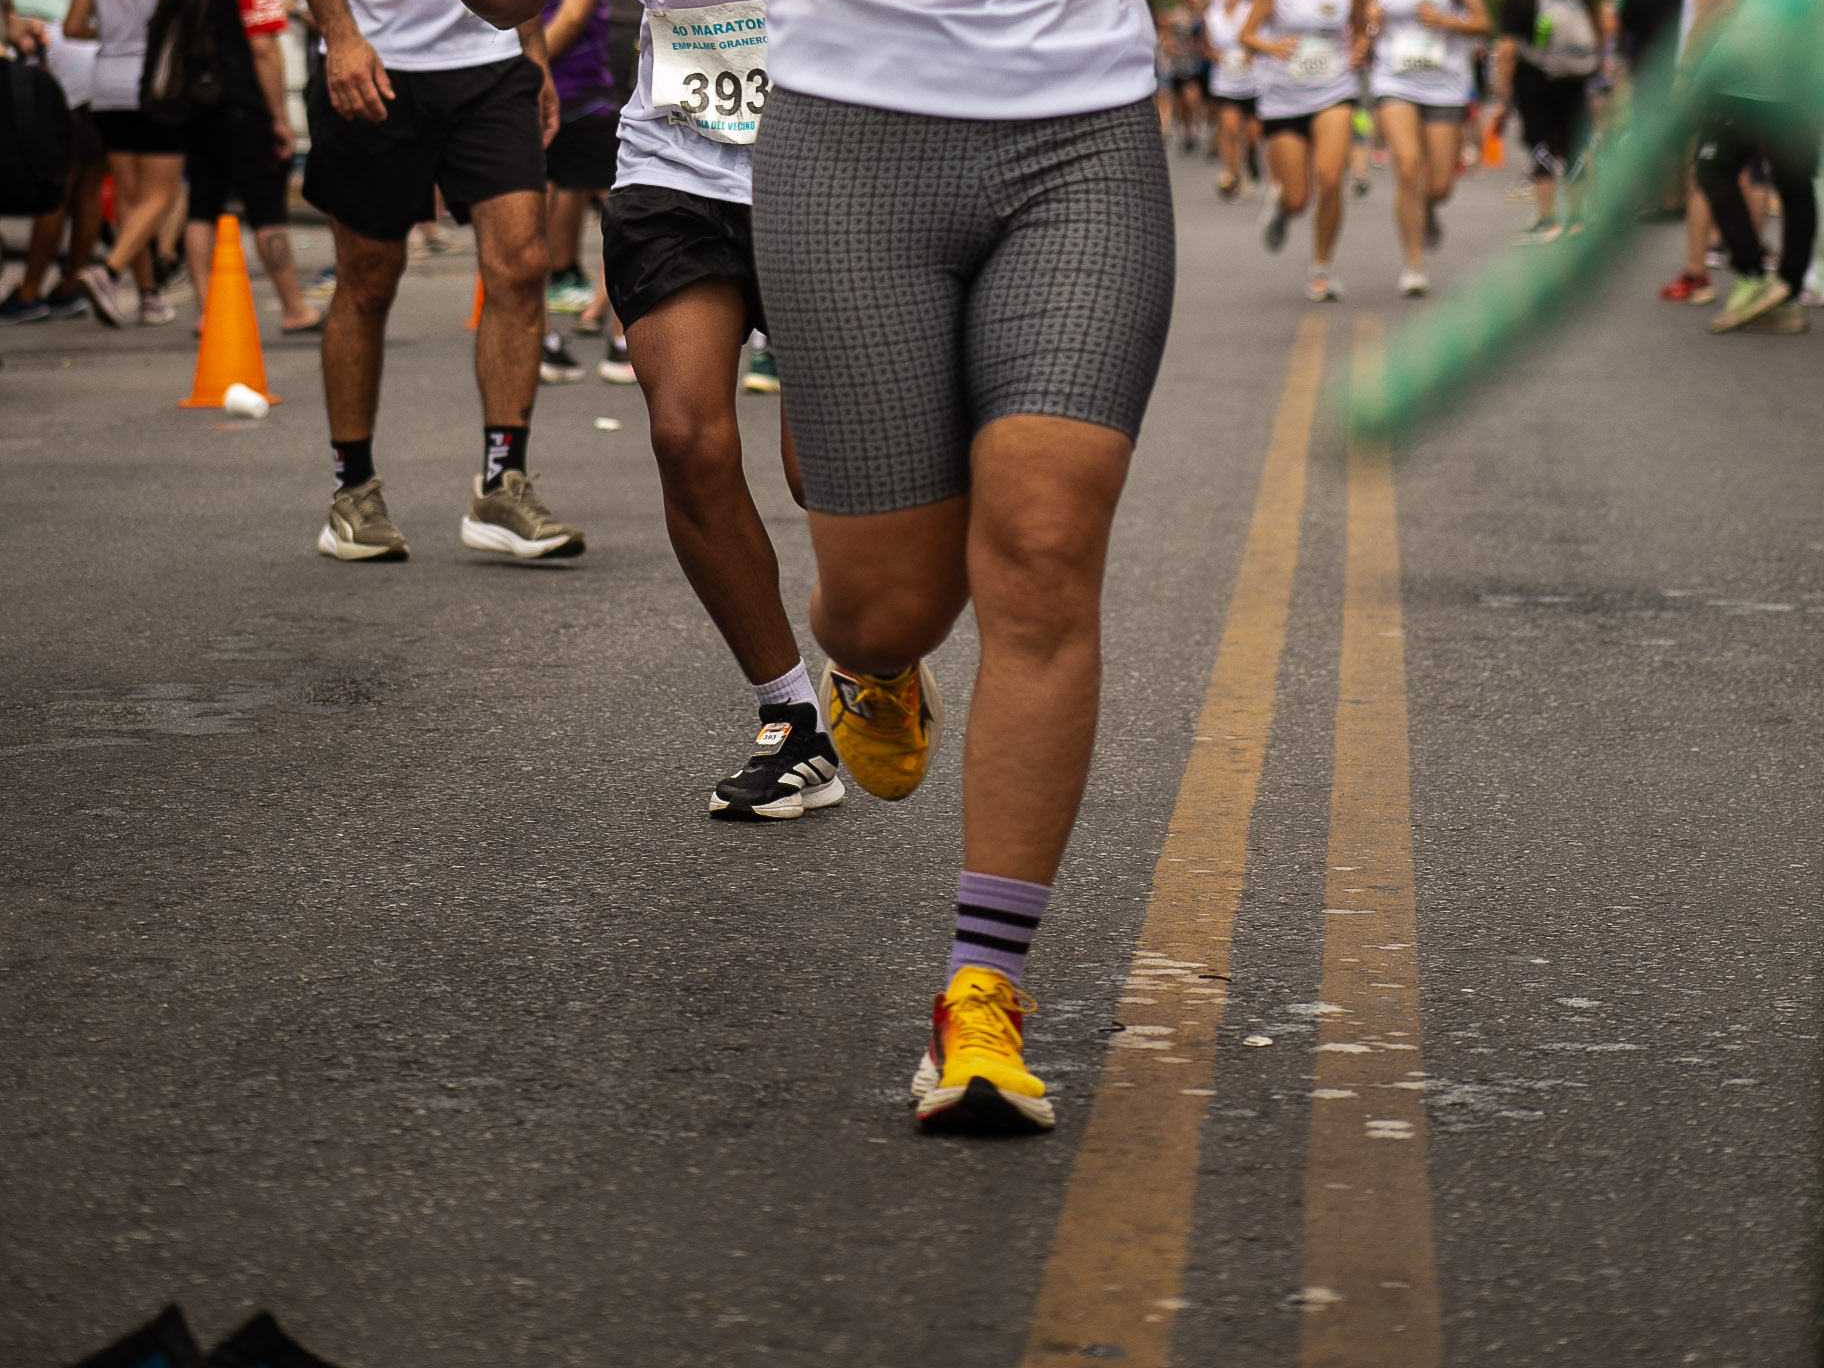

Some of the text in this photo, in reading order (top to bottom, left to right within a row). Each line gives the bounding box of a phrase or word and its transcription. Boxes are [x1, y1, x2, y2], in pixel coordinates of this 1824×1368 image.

[672, 18, 766, 36] 40 MARATON
[672, 36, 768, 50] EMPALME GRANERO
[680, 68, 769, 116] 393
[696, 120, 755, 130] DIA DEL VECINO
[487, 433, 512, 482] FILA
